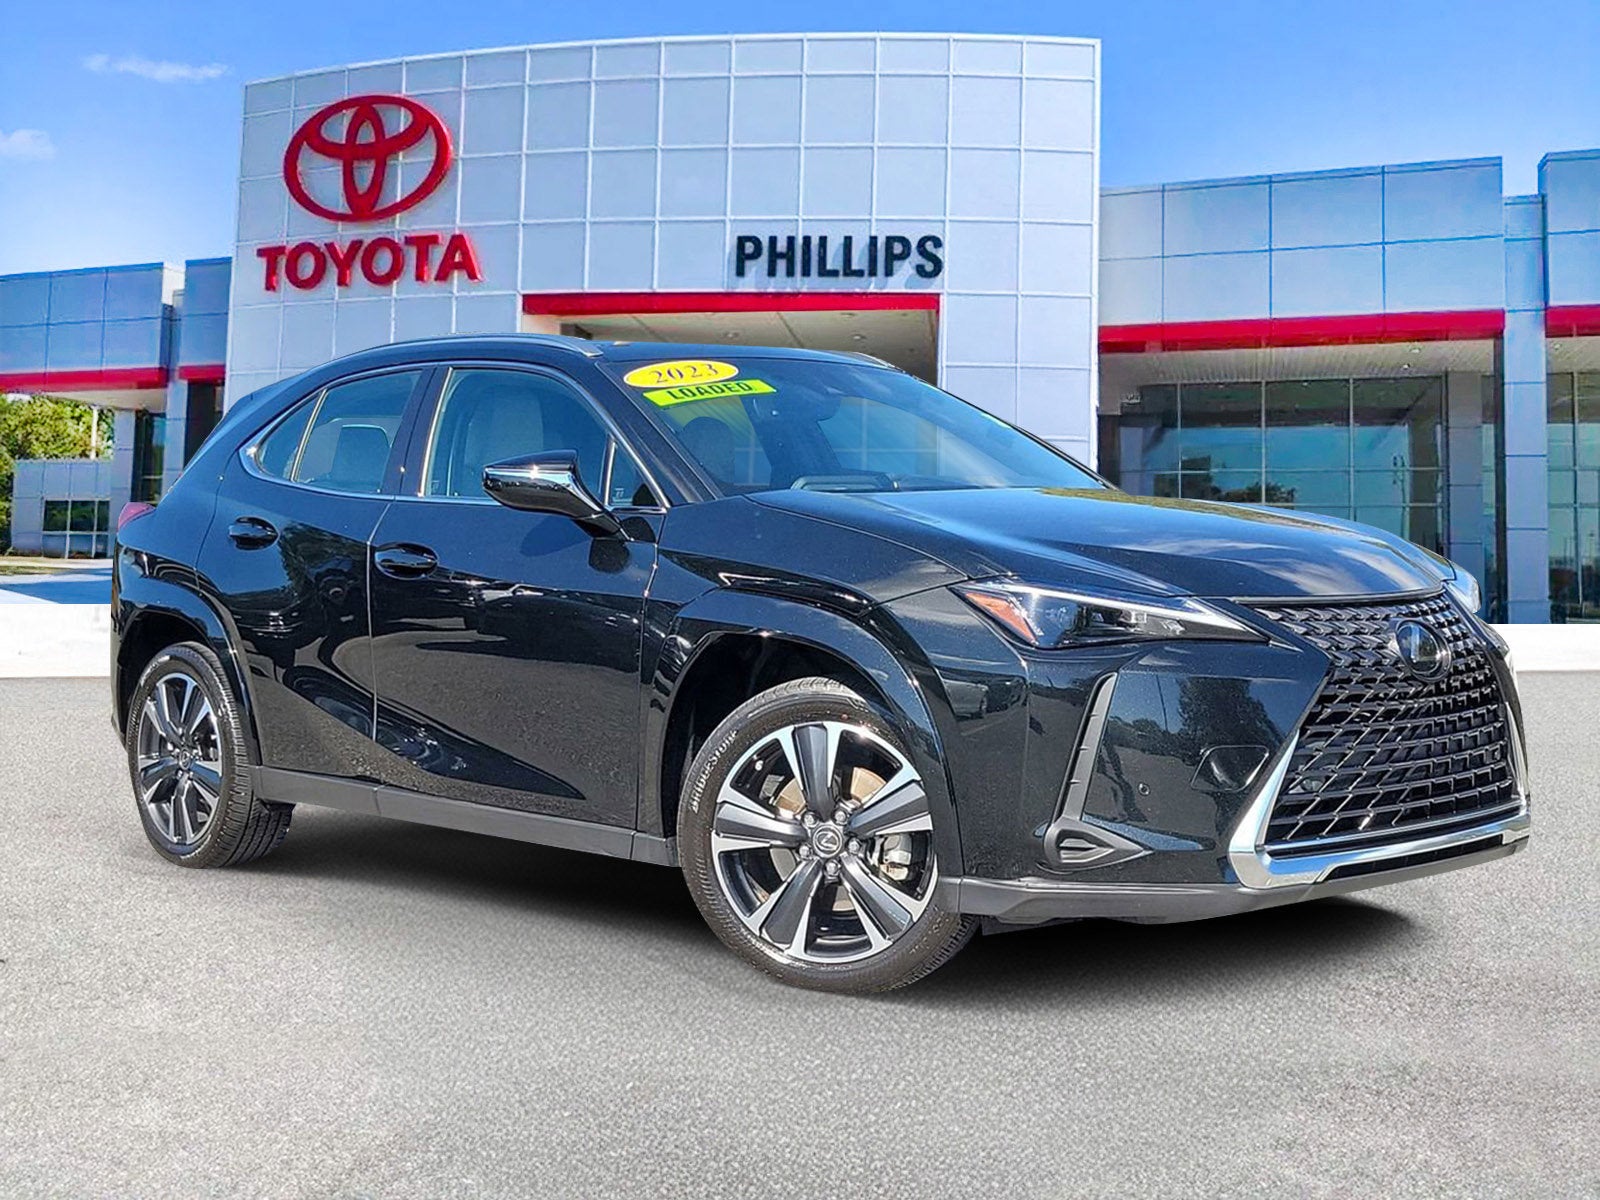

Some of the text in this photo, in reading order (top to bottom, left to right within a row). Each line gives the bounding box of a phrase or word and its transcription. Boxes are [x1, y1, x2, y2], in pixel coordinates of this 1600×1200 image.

[256, 234, 482, 291] TOYOTA
[736, 235, 943, 278] PHILLIPS
[650, 363, 719, 383] 2023
[667, 382, 753, 400] LOADED
